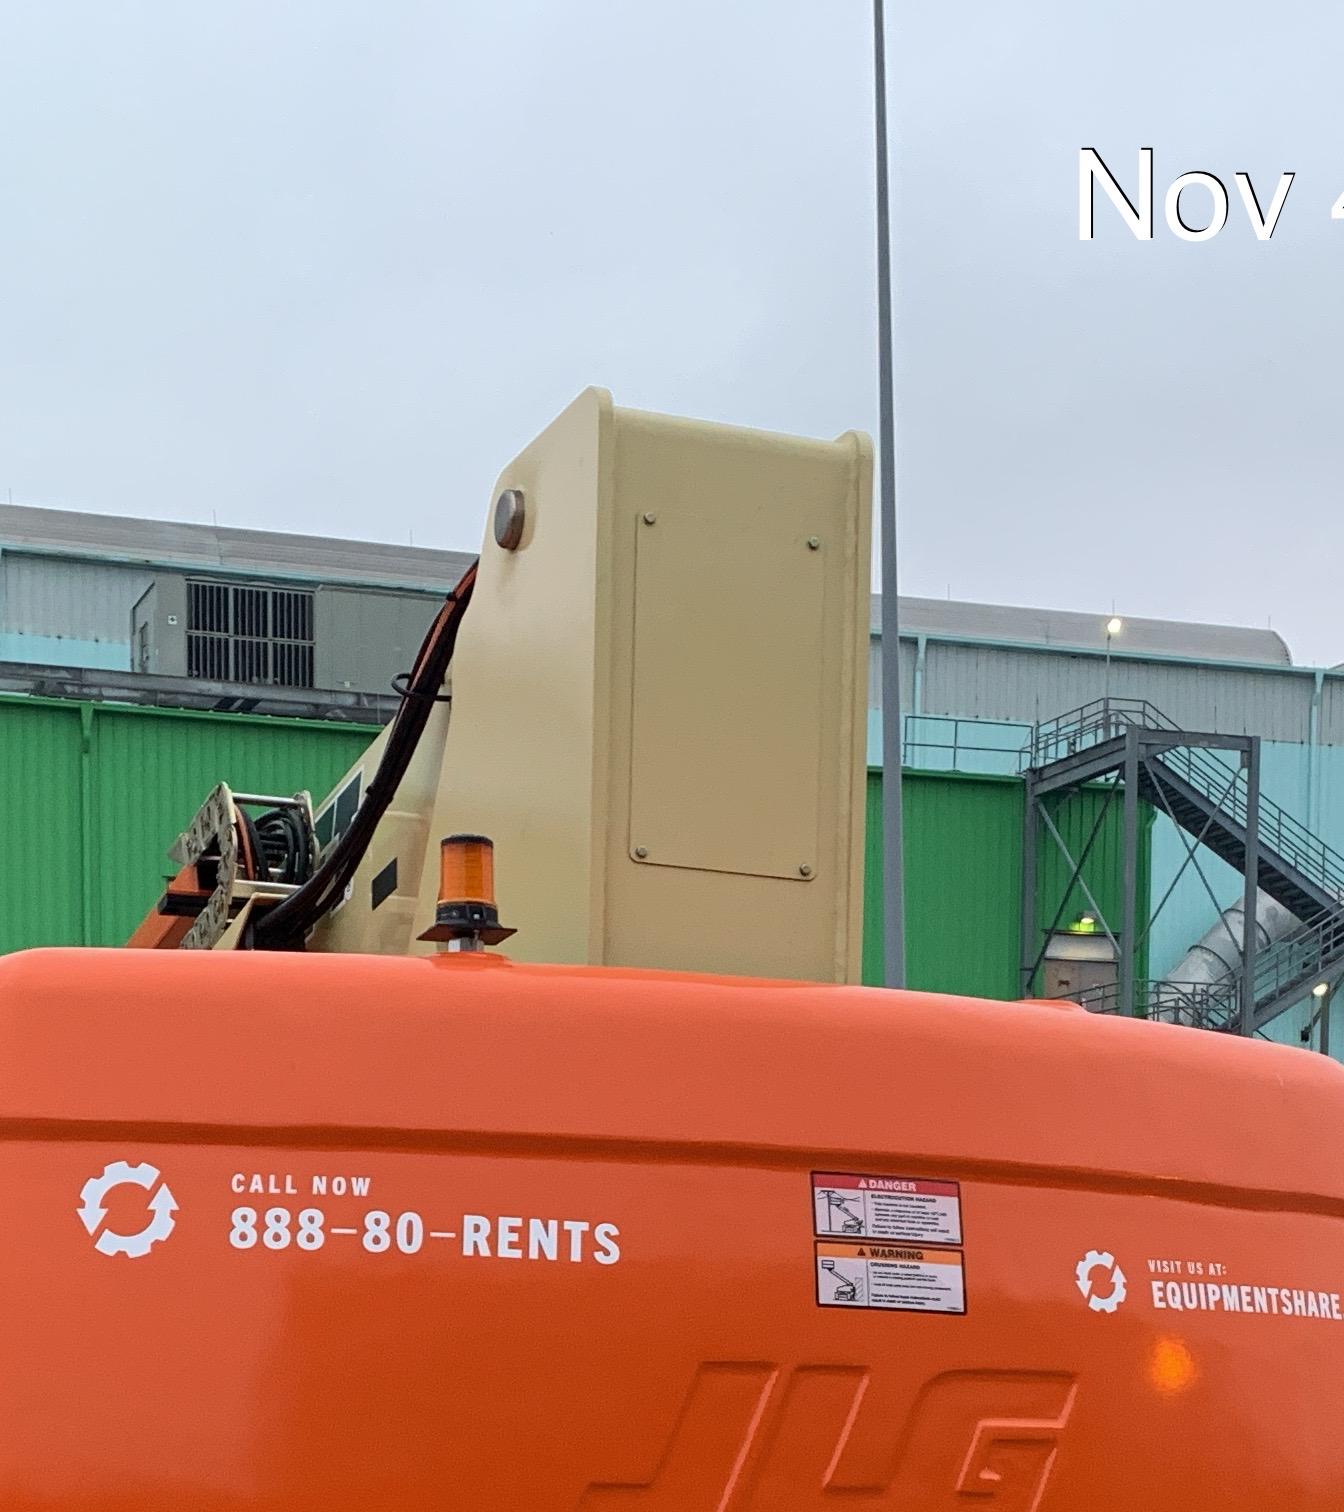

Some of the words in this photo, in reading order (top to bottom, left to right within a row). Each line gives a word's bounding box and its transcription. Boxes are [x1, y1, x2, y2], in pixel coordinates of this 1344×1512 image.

[230, 1173, 298, 1195] CALL
[312, 1176, 371, 1197] NOW
[868, 1178, 917, 1192] DANGER
[228, 1206, 622, 1266] 888-80-RENTS
[869, 1247, 924, 1260] WARNING
[1147, 1259, 1182, 1274] VISIT
[1187, 1261, 1204, 1275] US
[1208, 1263, 1228, 1276] AT:
